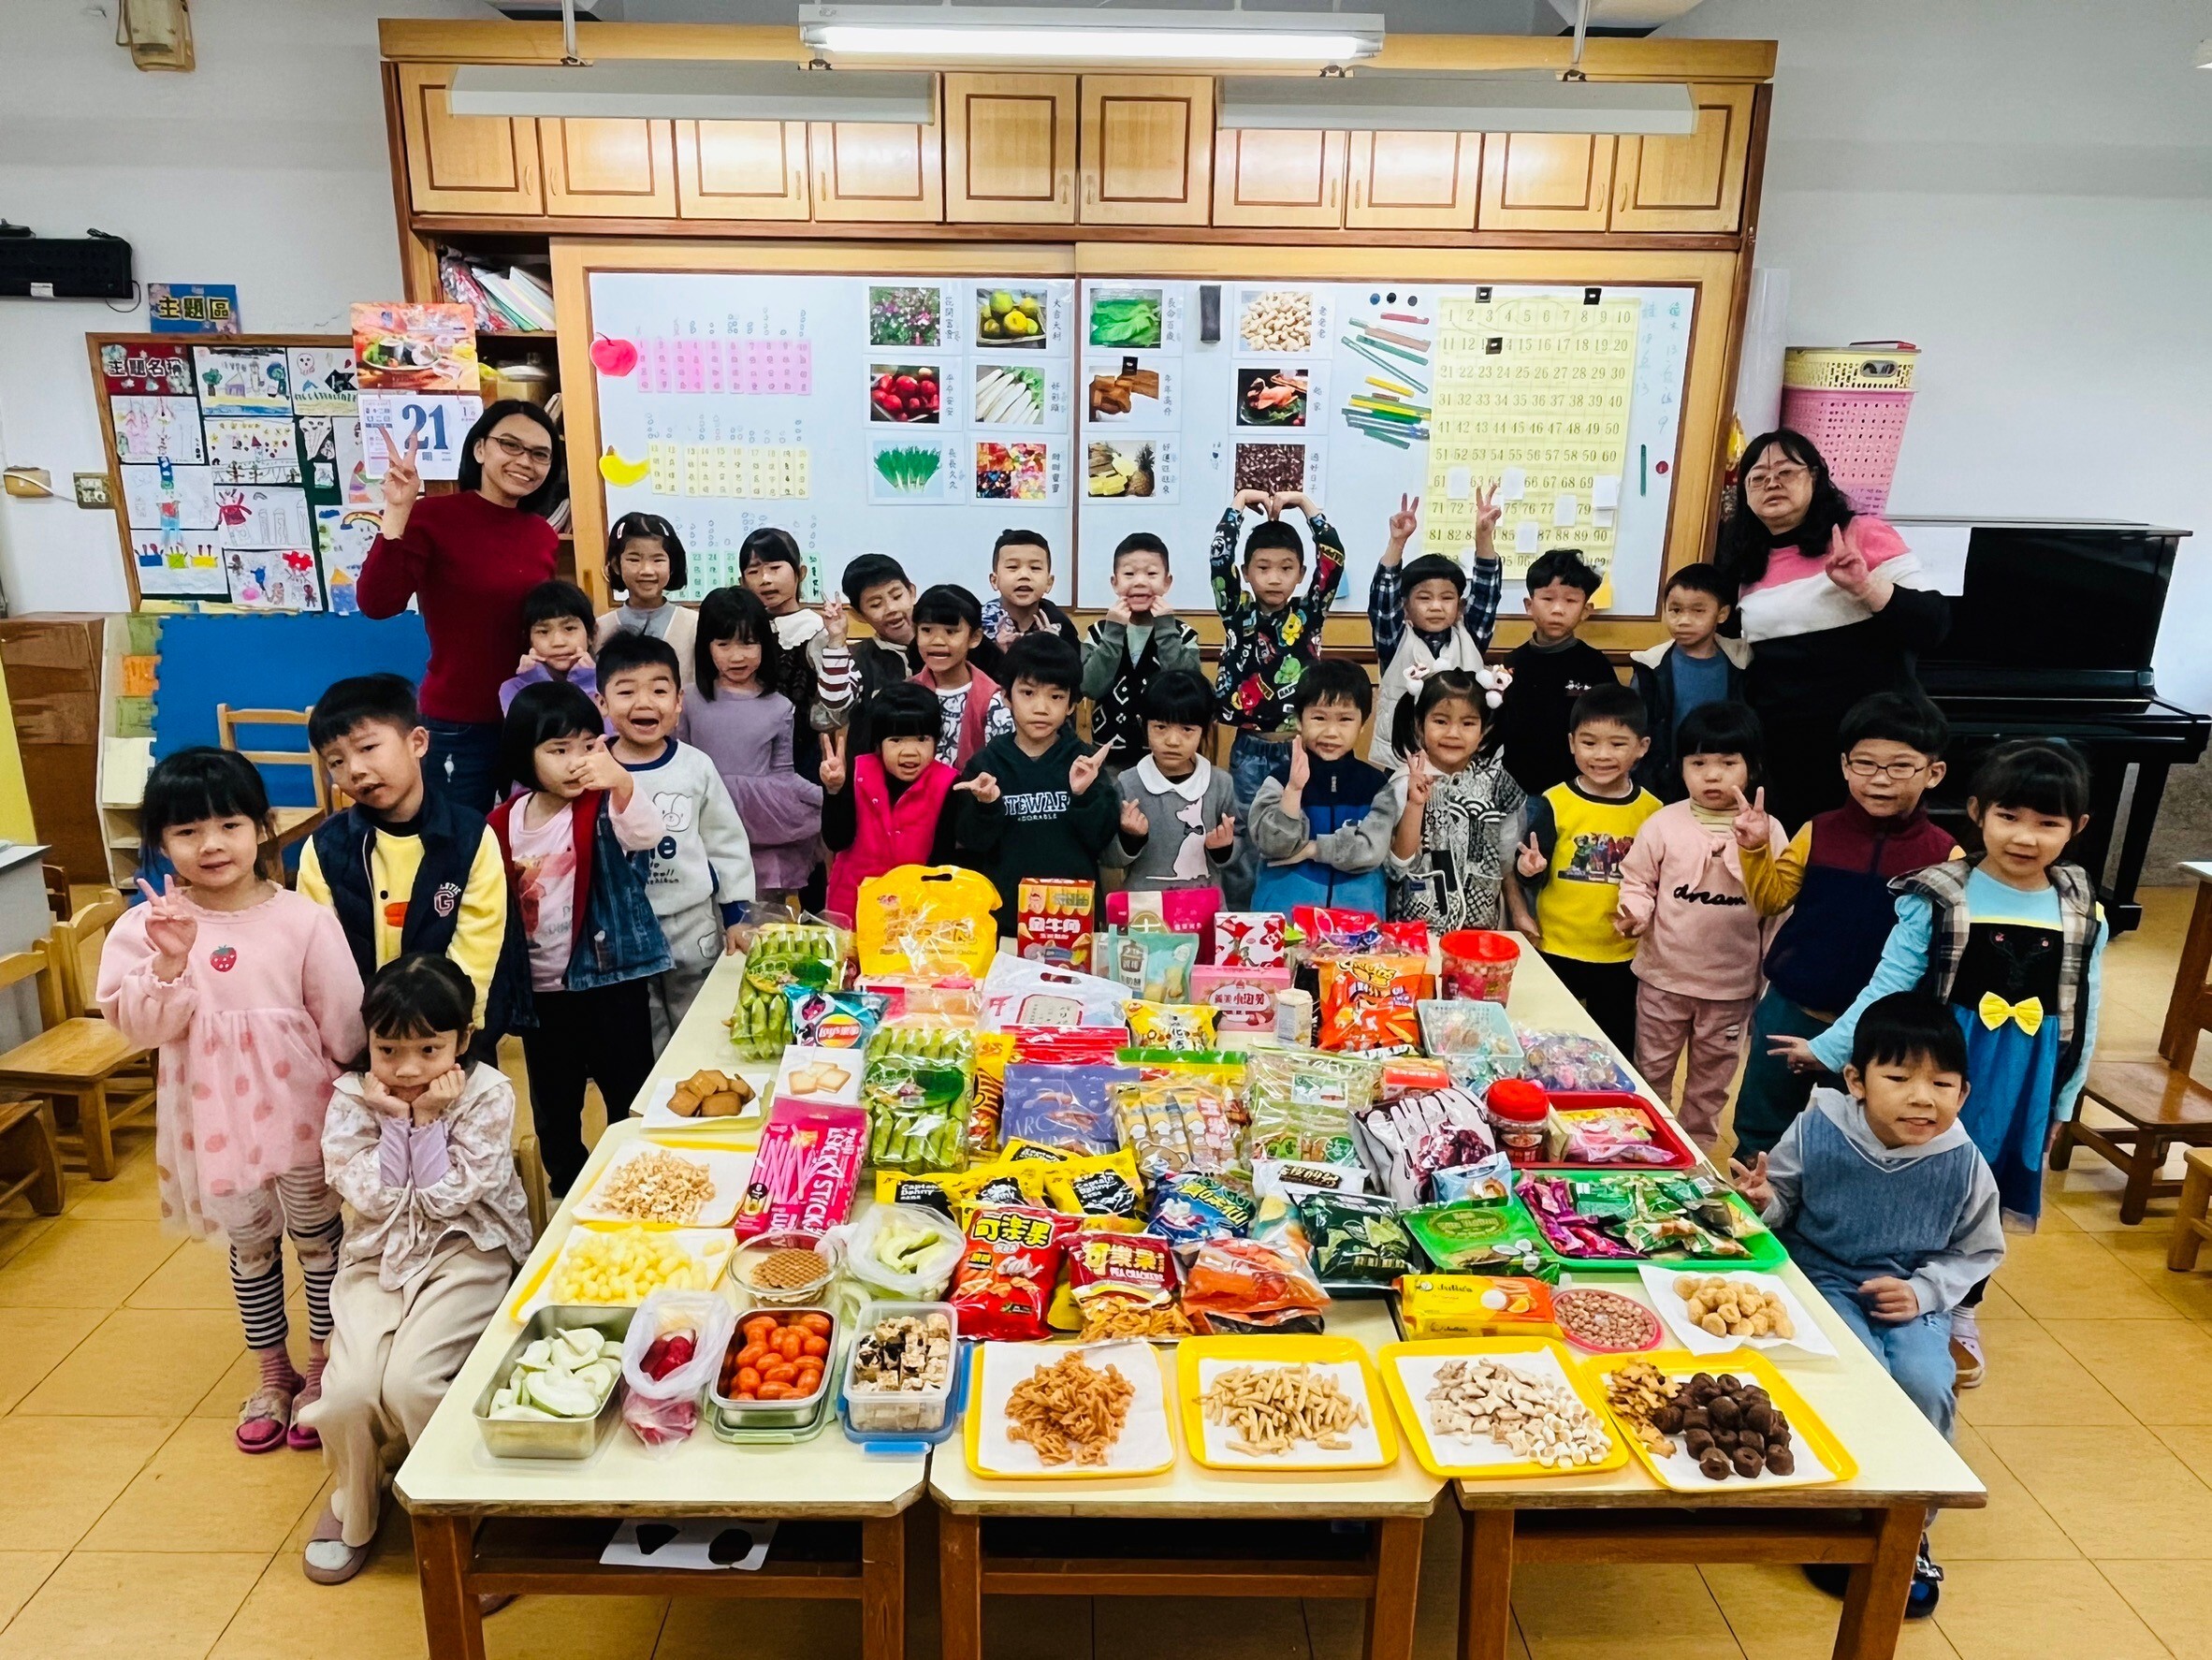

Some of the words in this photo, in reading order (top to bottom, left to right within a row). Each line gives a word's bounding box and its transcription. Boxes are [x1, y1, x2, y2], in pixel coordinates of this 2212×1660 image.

[159, 297, 229, 319] 主題區
[1448, 311, 1452, 322] 1
[1467, 311, 1474, 322] 2
[1486, 311, 1492, 322] 3
[1505, 311, 1511, 322] 4
[1524, 311, 1531, 322] 5
[1544, 311, 1550, 322] 6
[1564, 311, 1569, 322] 7
[1581, 311, 1588, 322] 8
[1600, 311, 1607, 322] 9
[1618, 311, 1630, 322] 10
[1443, 338, 1454, 351] 11
[1462, 338, 1475, 351] 12
[1520, 338, 1532, 351] 15
[1538, 338, 1550, 351] 16
[1557, 338, 1570, 351] 17
[1576, 338, 1589, 351] 18
[1595, 338, 1608, 351] 19
[1614, 338, 1627, 351] 20
[1441, 367, 1452, 379] 21
[1460, 367, 1474, 379] 22
[1478, 367, 1492, 379] 23
[1497, 367, 1510, 379] 24
[1516, 367, 1529, 379] 25
[1535, 367, 1548, 379] 26
[1553, 367, 1566, 379] 27
[1572, 367, 1586, 379] 28
[1592, 367, 1605, 379] 29
[1611, 367, 1624, 379] 30
[1439, 393, 1450, 406] 31
[1458, 393, 1471, 406] 32
[1476, 393, 1490, 406] 33
[1495, 393, 1507, 406] 34
[1513, 393, 1526, 406] 35
[1533, 393, 1545, 406] 36
[1550, 393, 1564, 406] 37
[1569, 393, 1583, 406] 38
[1589, 393, 1602, 406] 39
[1608, 393, 1622, 406] 40
[402, 404, 448, 449] 21
[1438, 422, 1449, 434] 41
[1456, 422, 1469, 434] 42
[1475, 422, 1488, 434] 43
[1493, 422, 1506, 434] 44
[1511, 422, 1524, 434] 45
[1529, 422, 1543, 434] 46
[1548, 422, 1562, 434] 47
[1566, 422, 1580, 434] 48
[1585, 422, 1599, 434] 49
[1606, 422, 1619, 434] 50
[1435, 449, 1448, 461] 51
[1454, 449, 1467, 461] 52
[1472, 449, 1486, 461] 53
[1491, 449, 1504, 461] 54
[1508, 449, 1522, 461] 55
[1527, 449, 1540, 461] 56
[1546, 449, 1559, 461] 57
[1564, 449, 1578, 461] 58
[1602, 449, 1616, 461] 60
[1433, 475, 1445, 488] 61
[1524, 475, 1537, 488] 66
[1543, 475, 1556, 488] 67
[1562, 475, 1575, 488] 68
[1580, 475, 1593, 488] 69
[1432, 502, 1443, 515] 71
[1450, 502, 1463, 515] 72
[1469, 502, 1477, 515] 7
[1505, 502, 1518, 515] 75
[1522, 502, 1535, 515] 76
[1541, 502, 1553, 515] 77
[1578, 502, 1591, 515] 79
[1430, 529, 1441, 541] 81
[1448, 529, 1461, 541] 82
[1501, 529, 1515, 541] 85
[1556, 529, 1569, 541] 88
[1574, 529, 1588, 541] 89
[1002, 791, 1070, 816] TEWAR
[1674, 883, 1746, 906] dream
[1437, 1282, 1473, 1292] Julie's
